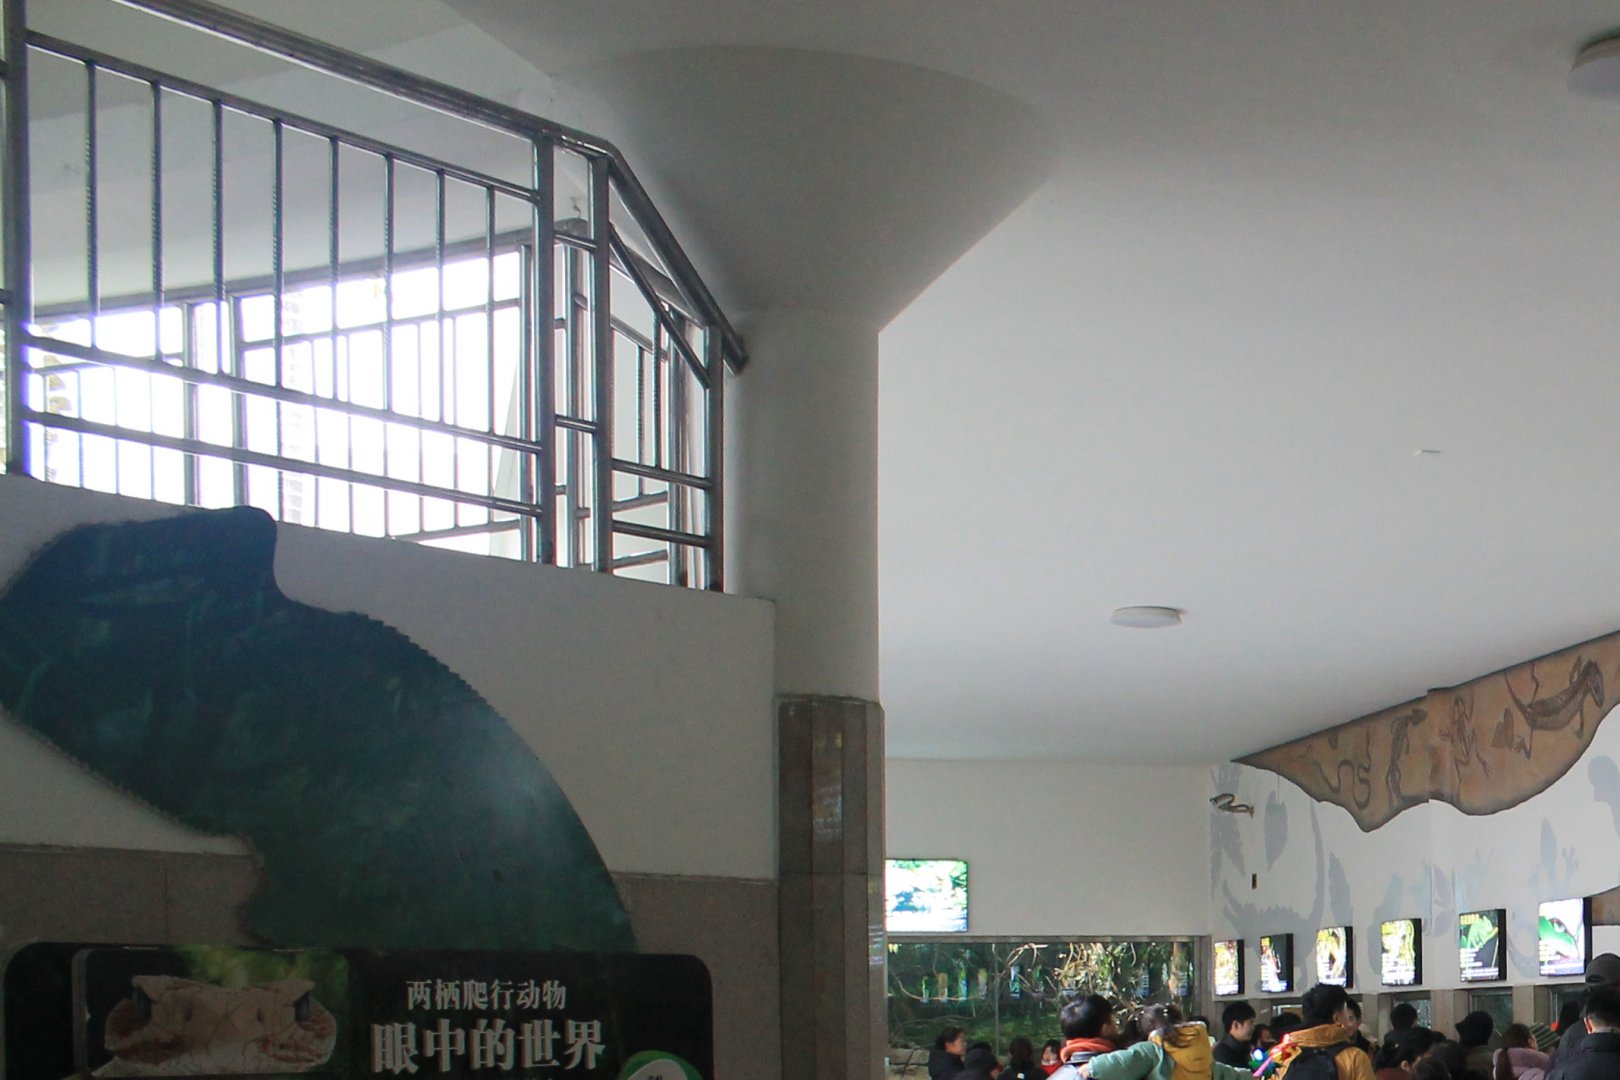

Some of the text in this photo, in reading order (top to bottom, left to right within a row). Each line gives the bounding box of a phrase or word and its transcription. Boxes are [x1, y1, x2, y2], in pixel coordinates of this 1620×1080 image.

[405, 978, 567, 1010] 两栖爬行动物
[370, 1018, 606, 1074] 眼中的世界
